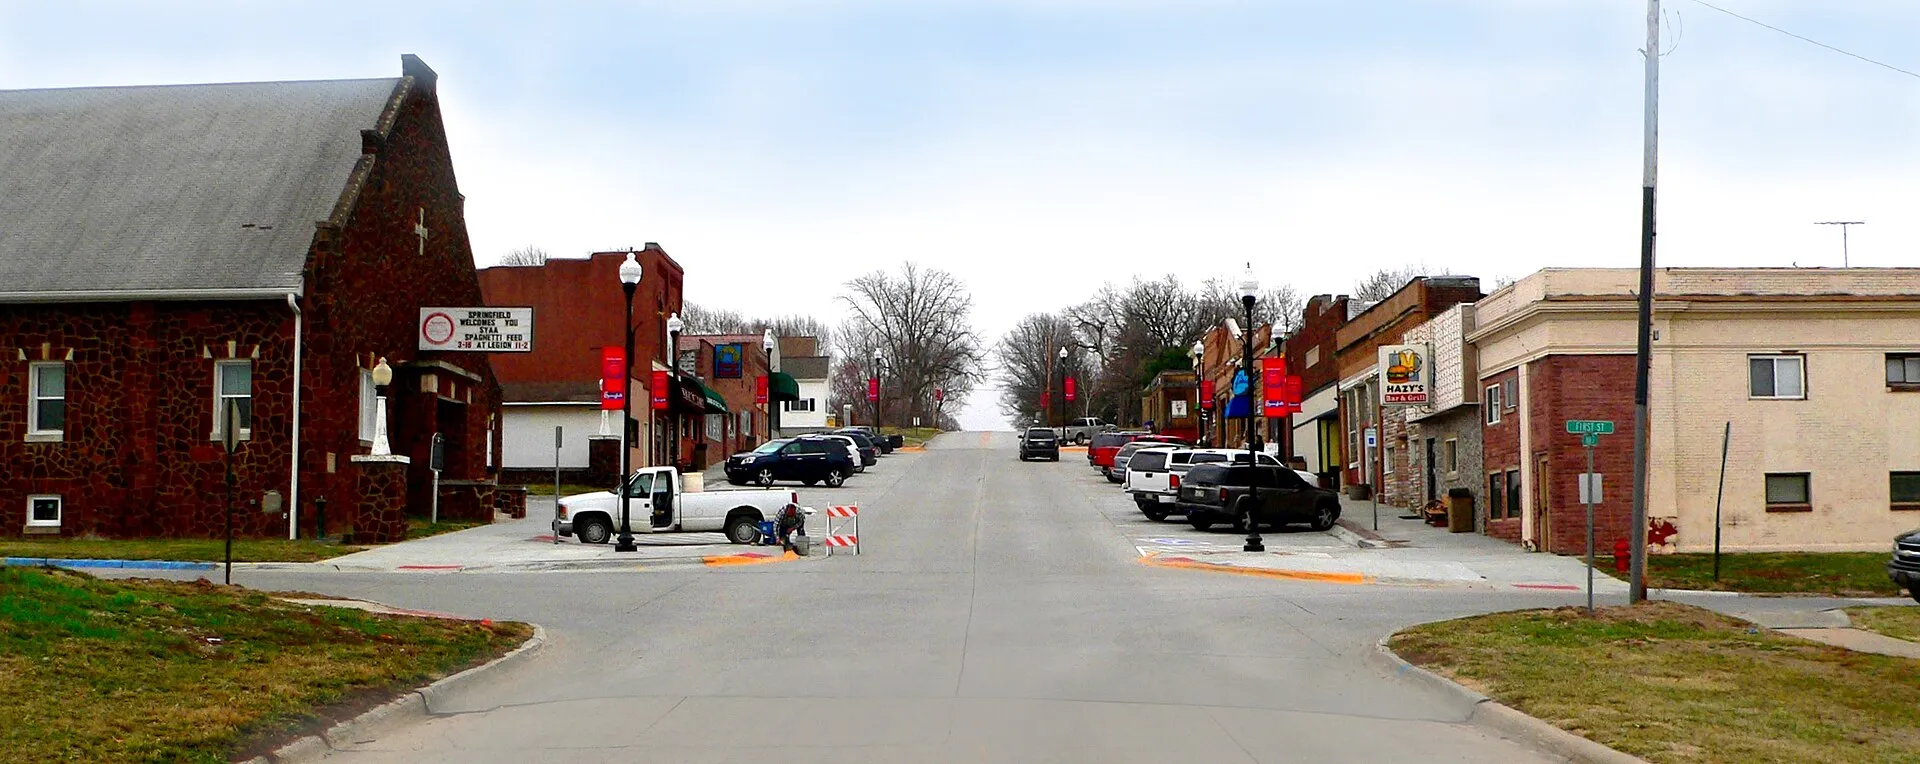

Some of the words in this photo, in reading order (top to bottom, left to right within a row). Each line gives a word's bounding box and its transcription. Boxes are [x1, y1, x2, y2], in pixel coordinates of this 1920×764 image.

[468, 311, 511, 319] SPRINGFIELD
[505, 319, 518, 327] YOU
[479, 326, 498, 334] SYAA
[476, 341, 485, 349] AT
[1575, 422, 1594, 431] FIRST
[1596, 423, 1604, 431] ST
